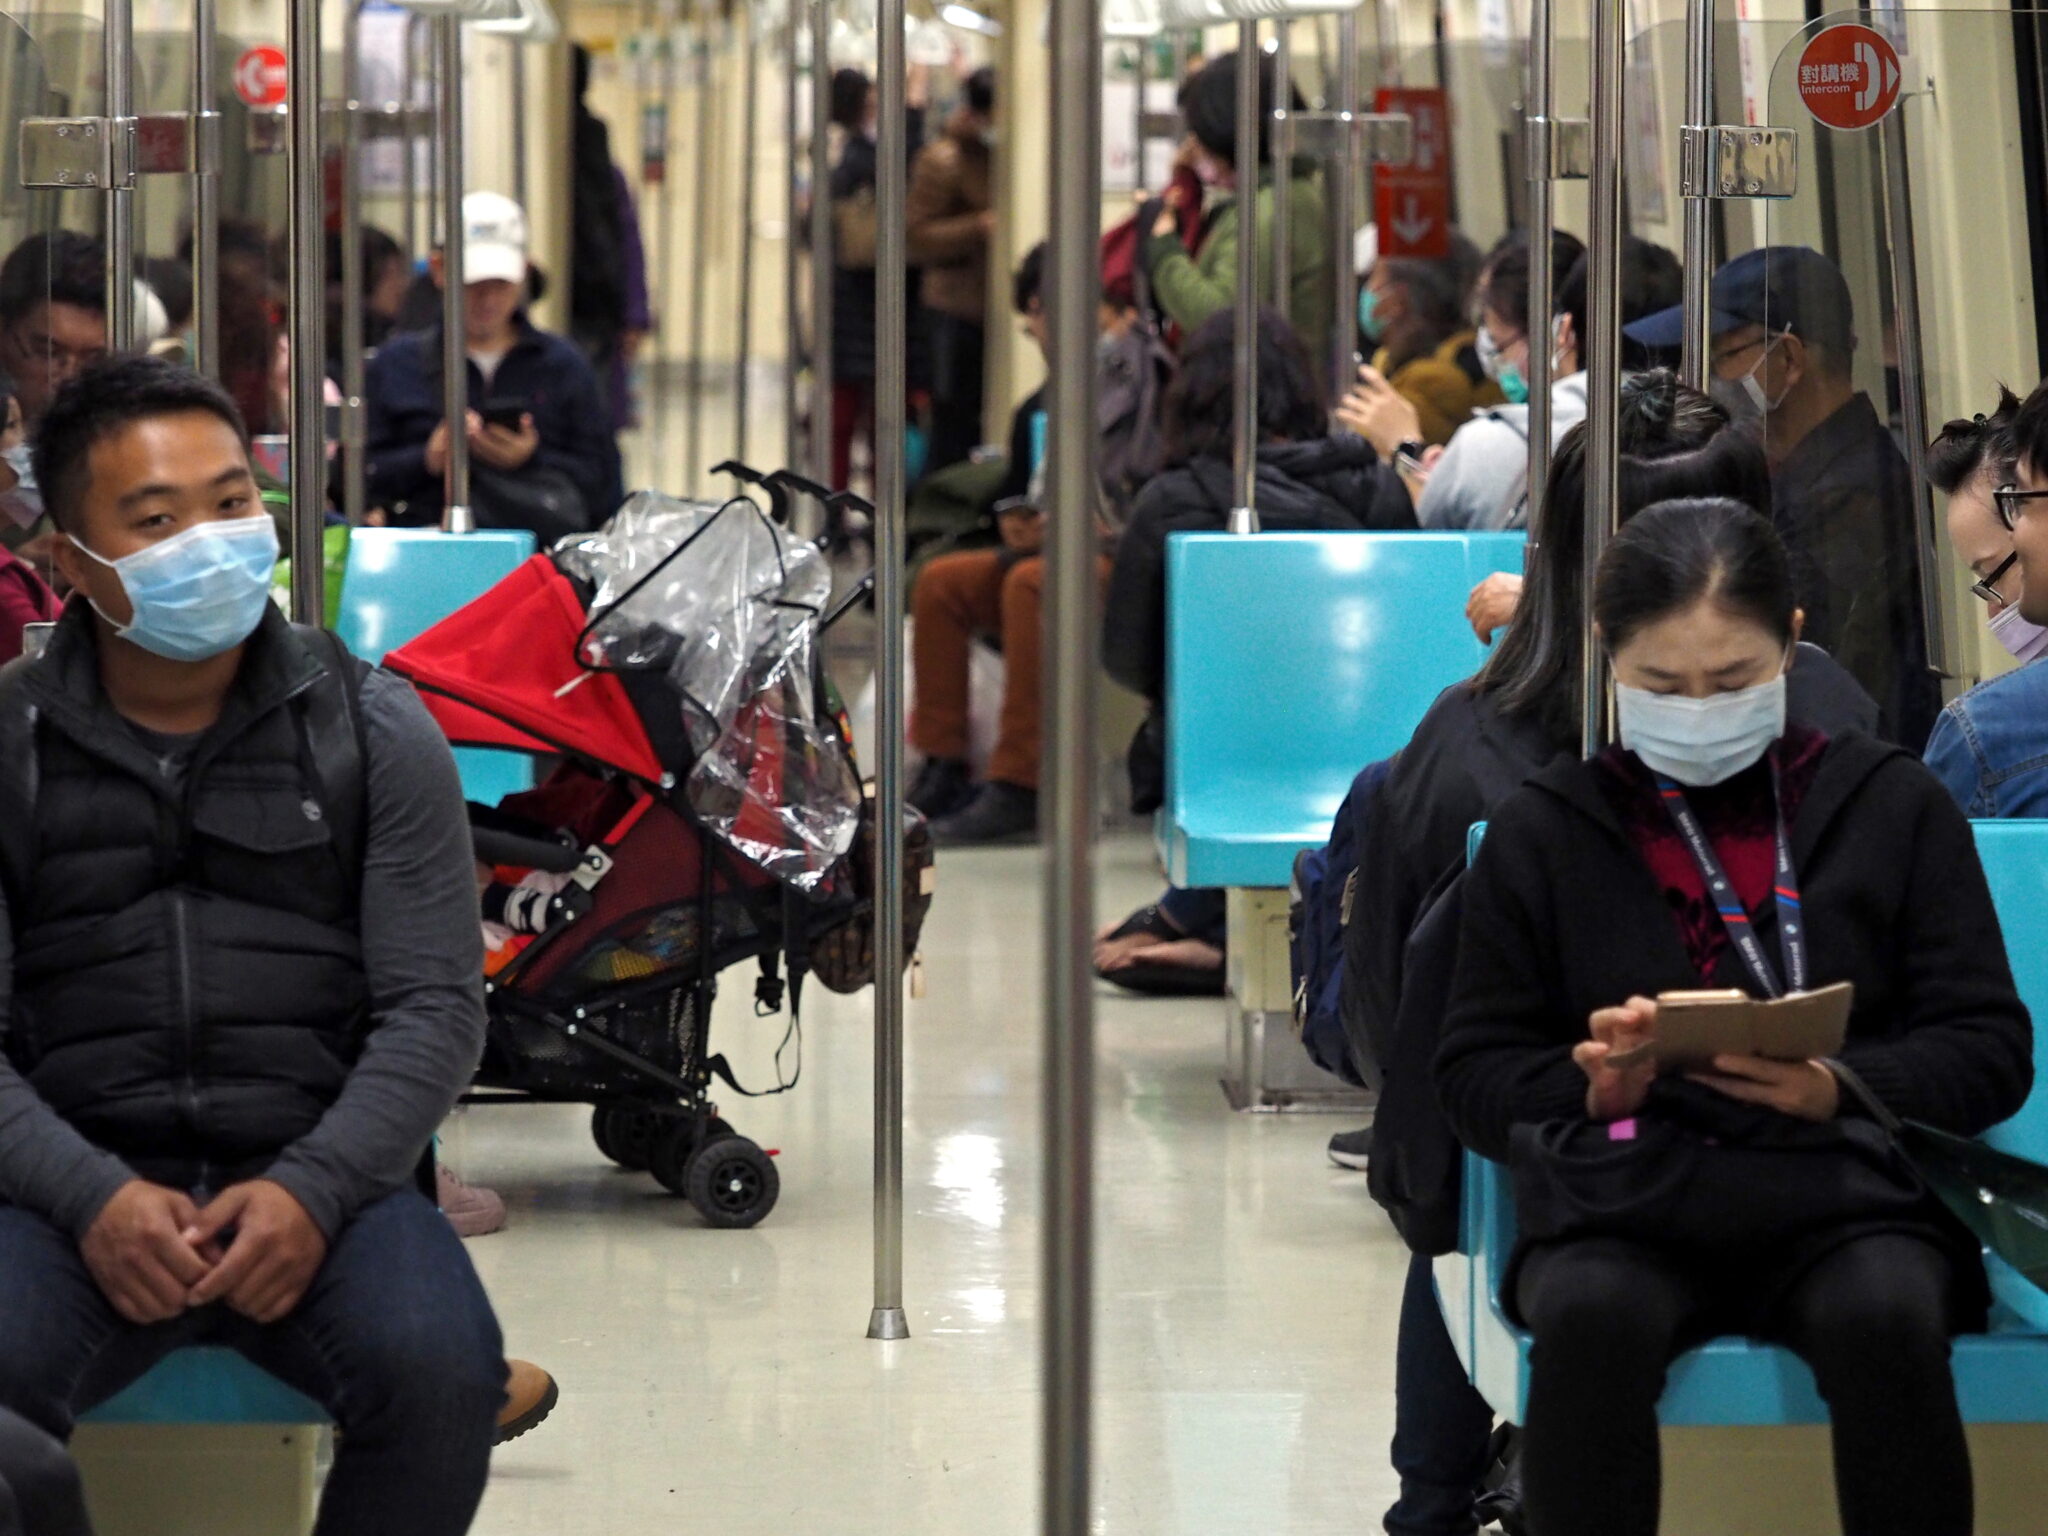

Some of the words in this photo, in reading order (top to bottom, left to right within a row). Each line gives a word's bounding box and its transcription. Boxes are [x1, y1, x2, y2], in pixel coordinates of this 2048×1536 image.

[1801, 63, 1860, 84] 對講機
[1801, 85, 1850, 94] Intercom
